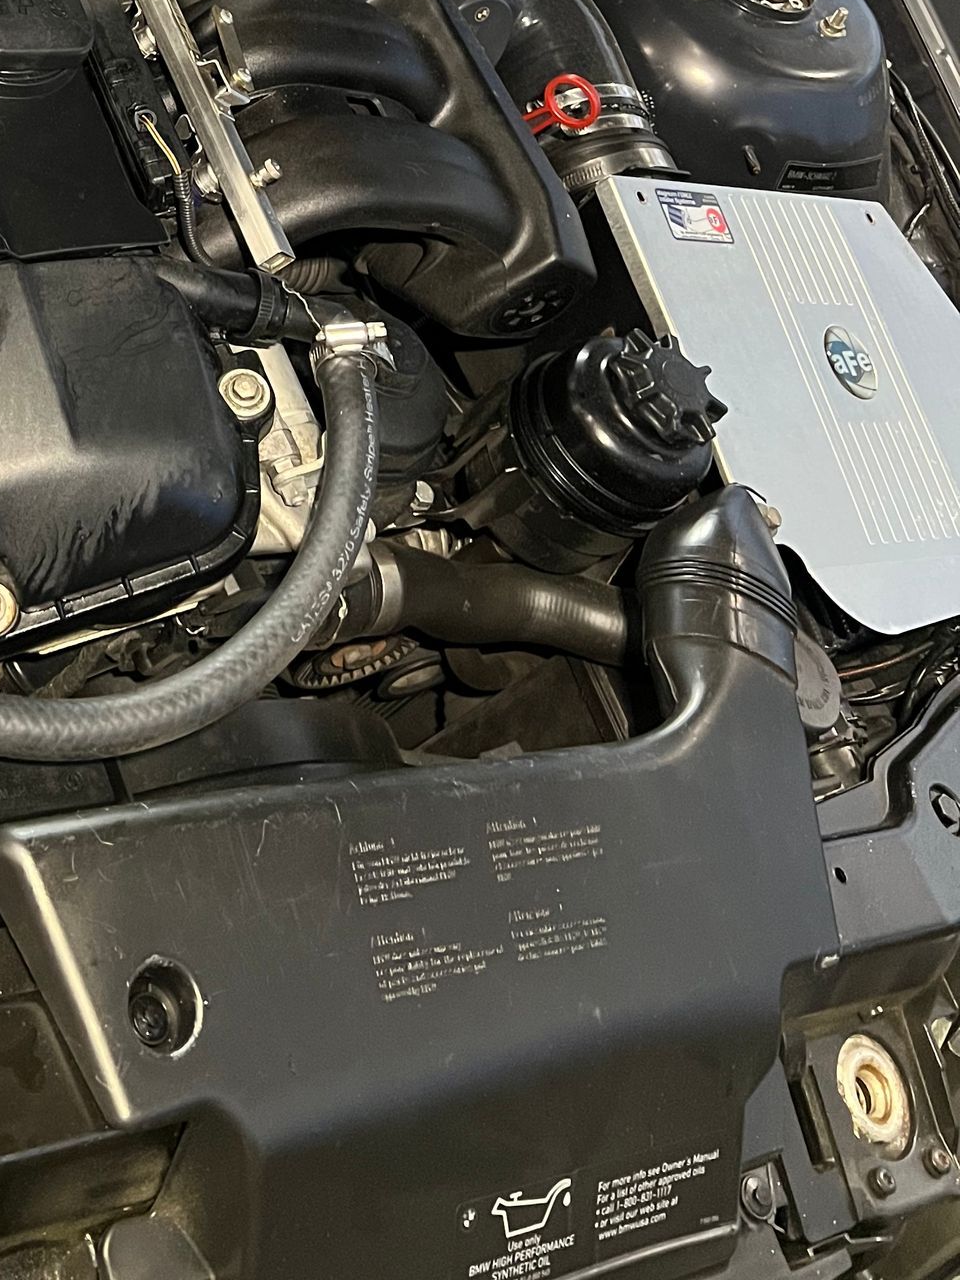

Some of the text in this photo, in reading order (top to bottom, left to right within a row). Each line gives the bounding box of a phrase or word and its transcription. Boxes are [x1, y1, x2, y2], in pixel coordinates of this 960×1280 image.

[831, 350, 873, 377] aFe
[360, 371, 375, 422] Heater
[350, 482, 372, 539] Safety
[596, 1194, 609, 1205] For
[616, 1186, 628, 1199] list
[629, 1183, 637, 1194] of
[637, 1179, 657, 1192] other
[658, 1168, 692, 1187] approved
[692, 1166, 705, 1177] oils
[598, 1181, 611, 1192] For
[611, 1175, 631, 1188] more
[632, 1169, 647, 1182] info
[647, 1166, 660, 1177] see
[692, 1148, 720, 1164] Manual
[599, 1196, 678, 1228] or visit our web site at
[601, 1202, 615, 1215] call
[468, 1260, 492, 1277] BMW
[491, 1253, 513, 1270] HIGH
[514, 1233, 575, 1262] PERFORMANCE
[507, 1233, 541, 1252] Use only
[491, 1259, 537, 1280] SYNTHETIC
[538, 1255, 551, 1270] OIL
